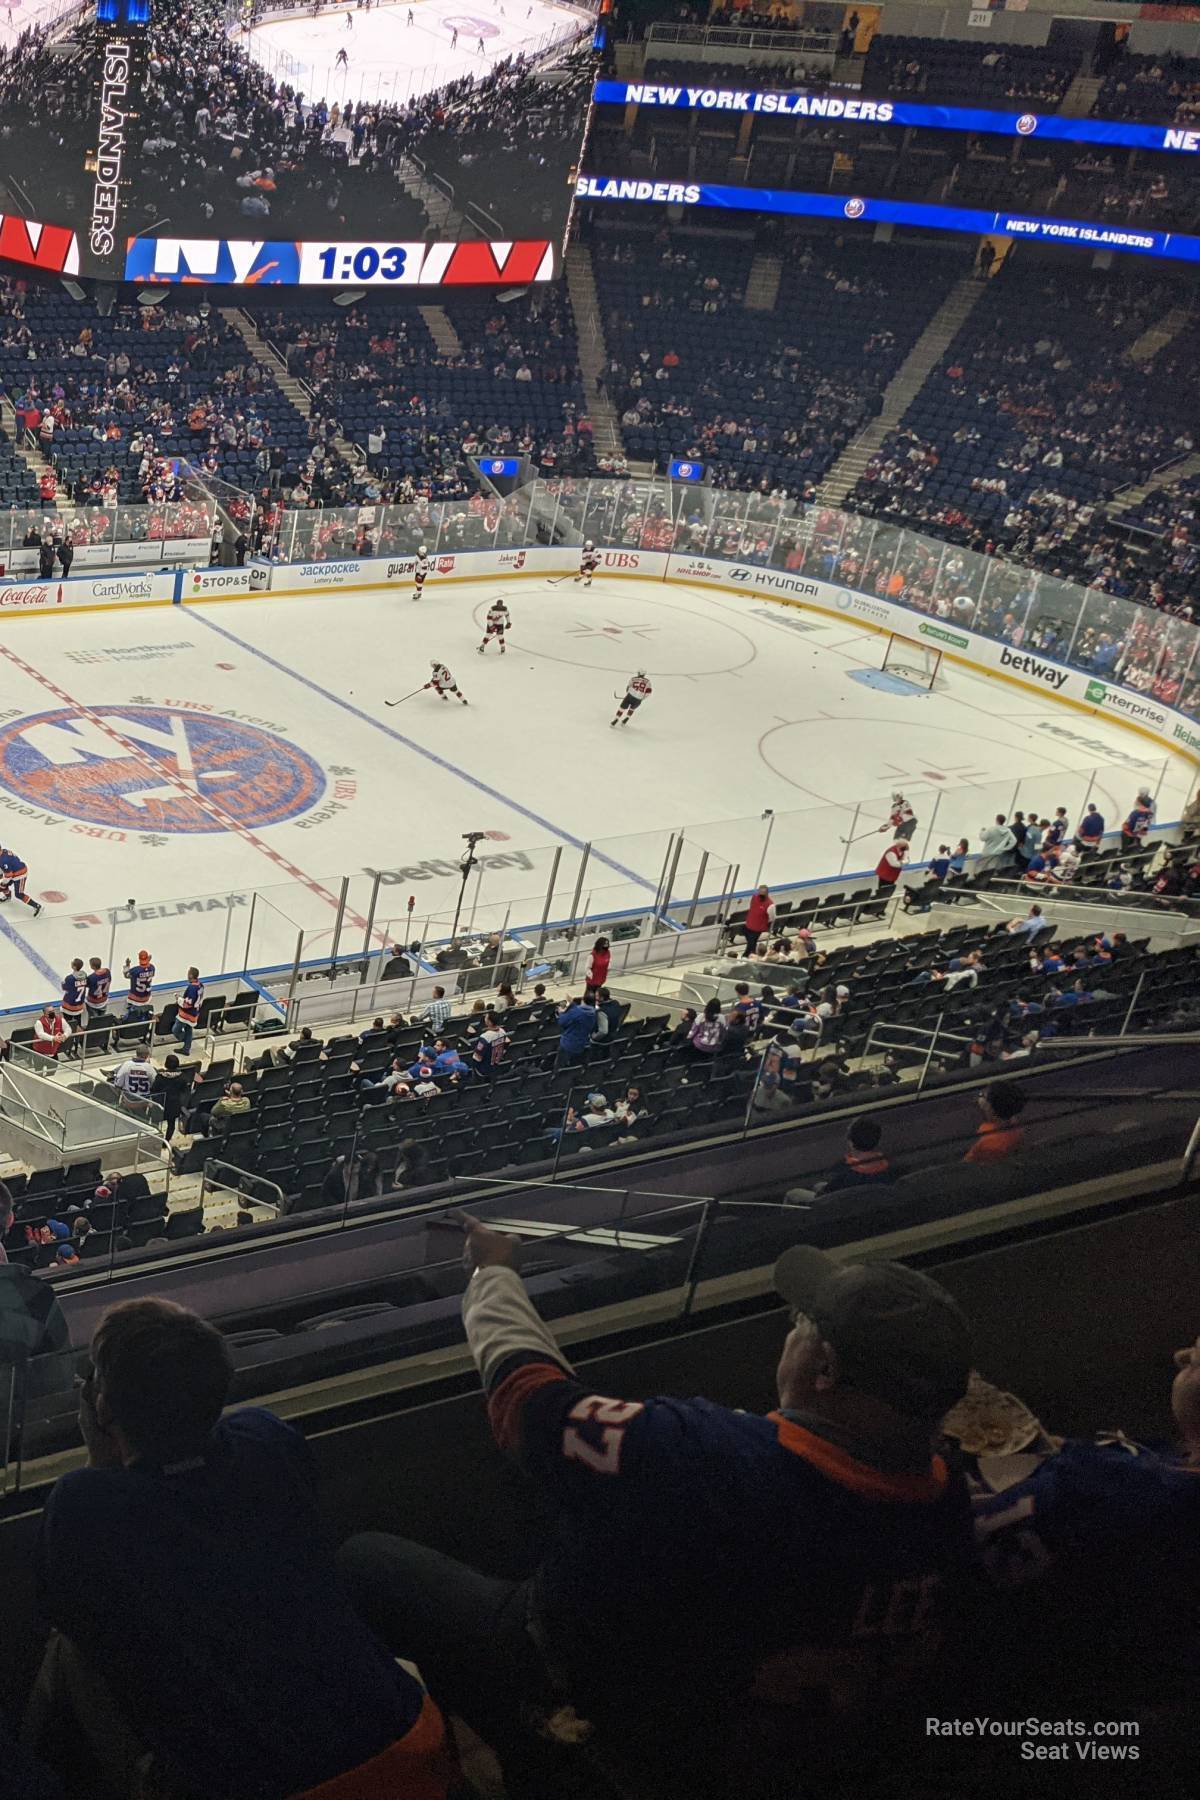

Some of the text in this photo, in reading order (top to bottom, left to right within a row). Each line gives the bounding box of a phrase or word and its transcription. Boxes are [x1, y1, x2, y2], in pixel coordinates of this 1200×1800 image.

[625, 84, 894, 122] NEW YORK ISLANDERS
[90, 45, 129, 256] ISLANDERS
[1006, 219, 1154, 248] NEW YORK ISLANDERS
[316, 246, 407, 281] 1:03
[387, 557, 437, 579] guarand
[605, 552, 640, 568] UBS
[92, 581, 153, 601] CardWorks
[755, 573, 819, 597] HYUNDAI
[1000, 647, 1069, 690] betway
[164, 698, 288, 733] UBS Arena
[1091, 687, 1166, 726] enterprise
[293, 779, 358, 829] UBS Arena
[68, 824, 127, 842] UBS
[107, 893, 250, 927] DELMAR
[128, 1077, 150, 1094] 55
[562, 1394, 646, 1477] 27
